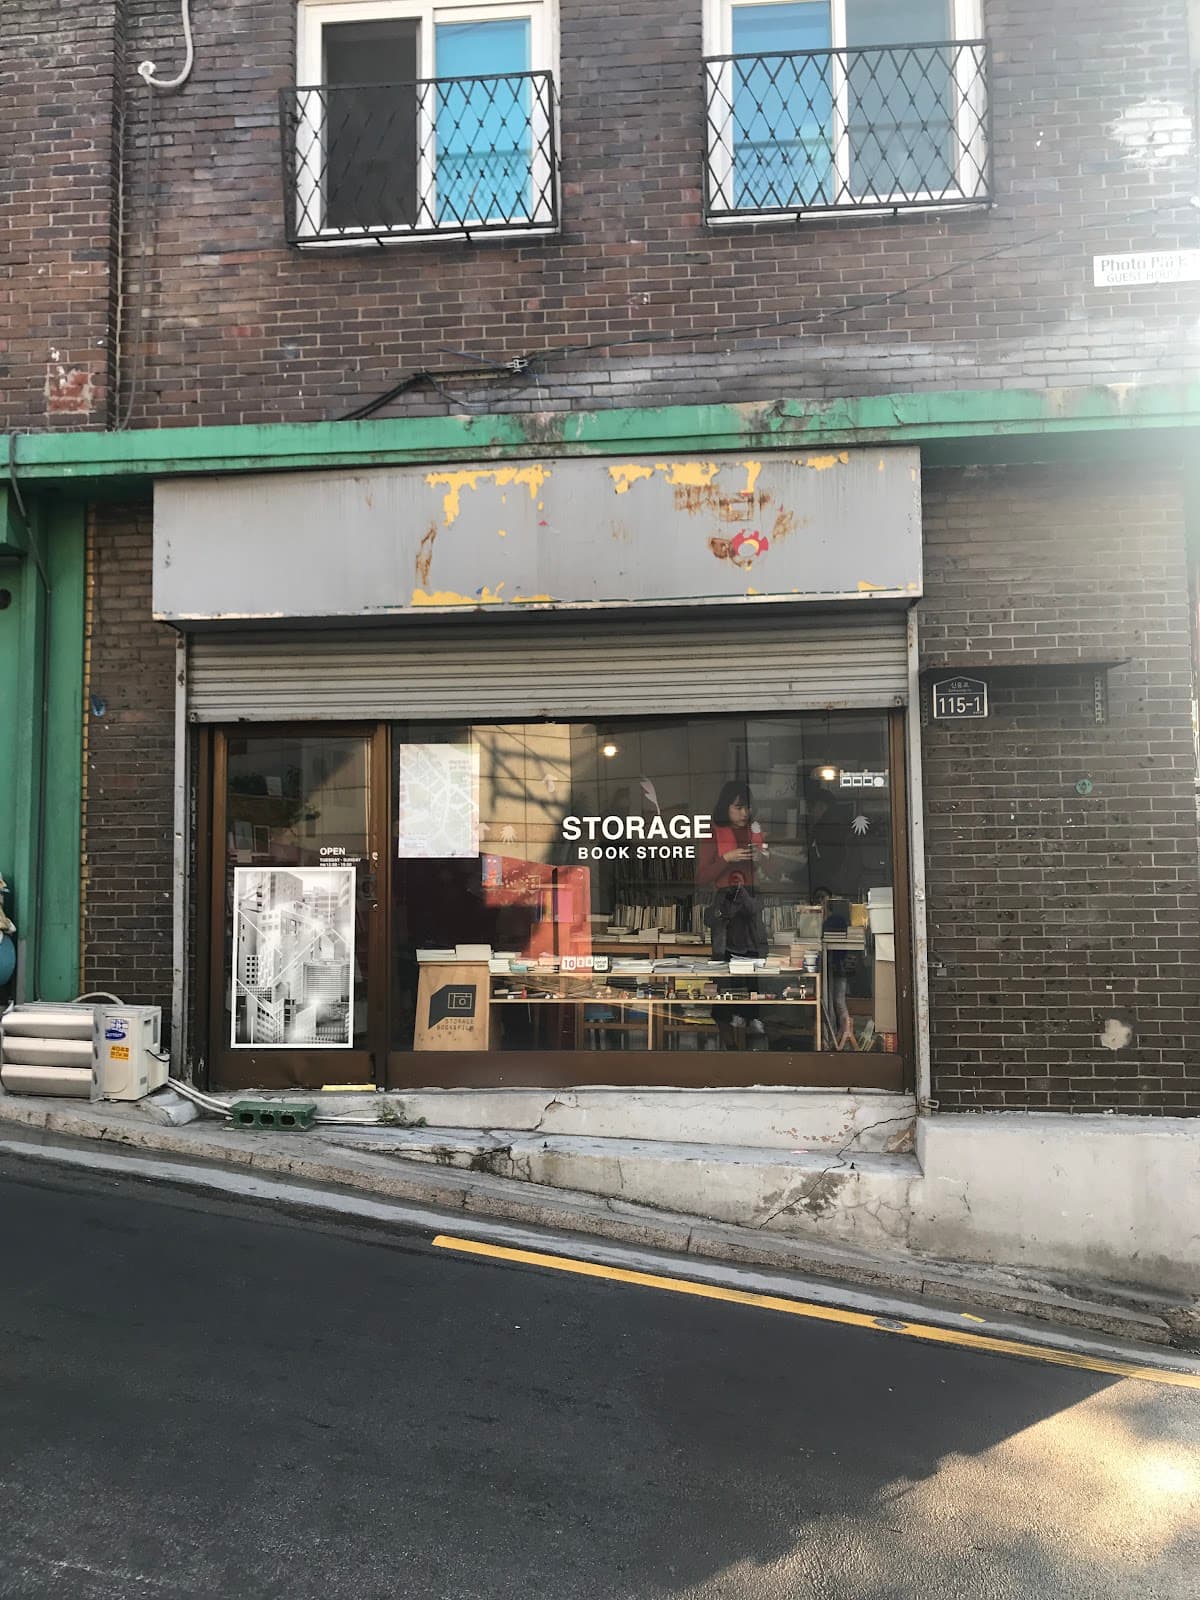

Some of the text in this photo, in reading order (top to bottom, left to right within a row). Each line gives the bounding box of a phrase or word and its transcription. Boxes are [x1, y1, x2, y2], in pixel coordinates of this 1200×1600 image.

[1101, 258, 1146, 272] Photo
[939, 696, 980, 713] 115-1
[562, 814, 713, 840] STORAGE
[320, 847, 345, 856] OPEN
[578, 846, 696, 860] BOOK STORE
[564, 959, 575, 969] 10
